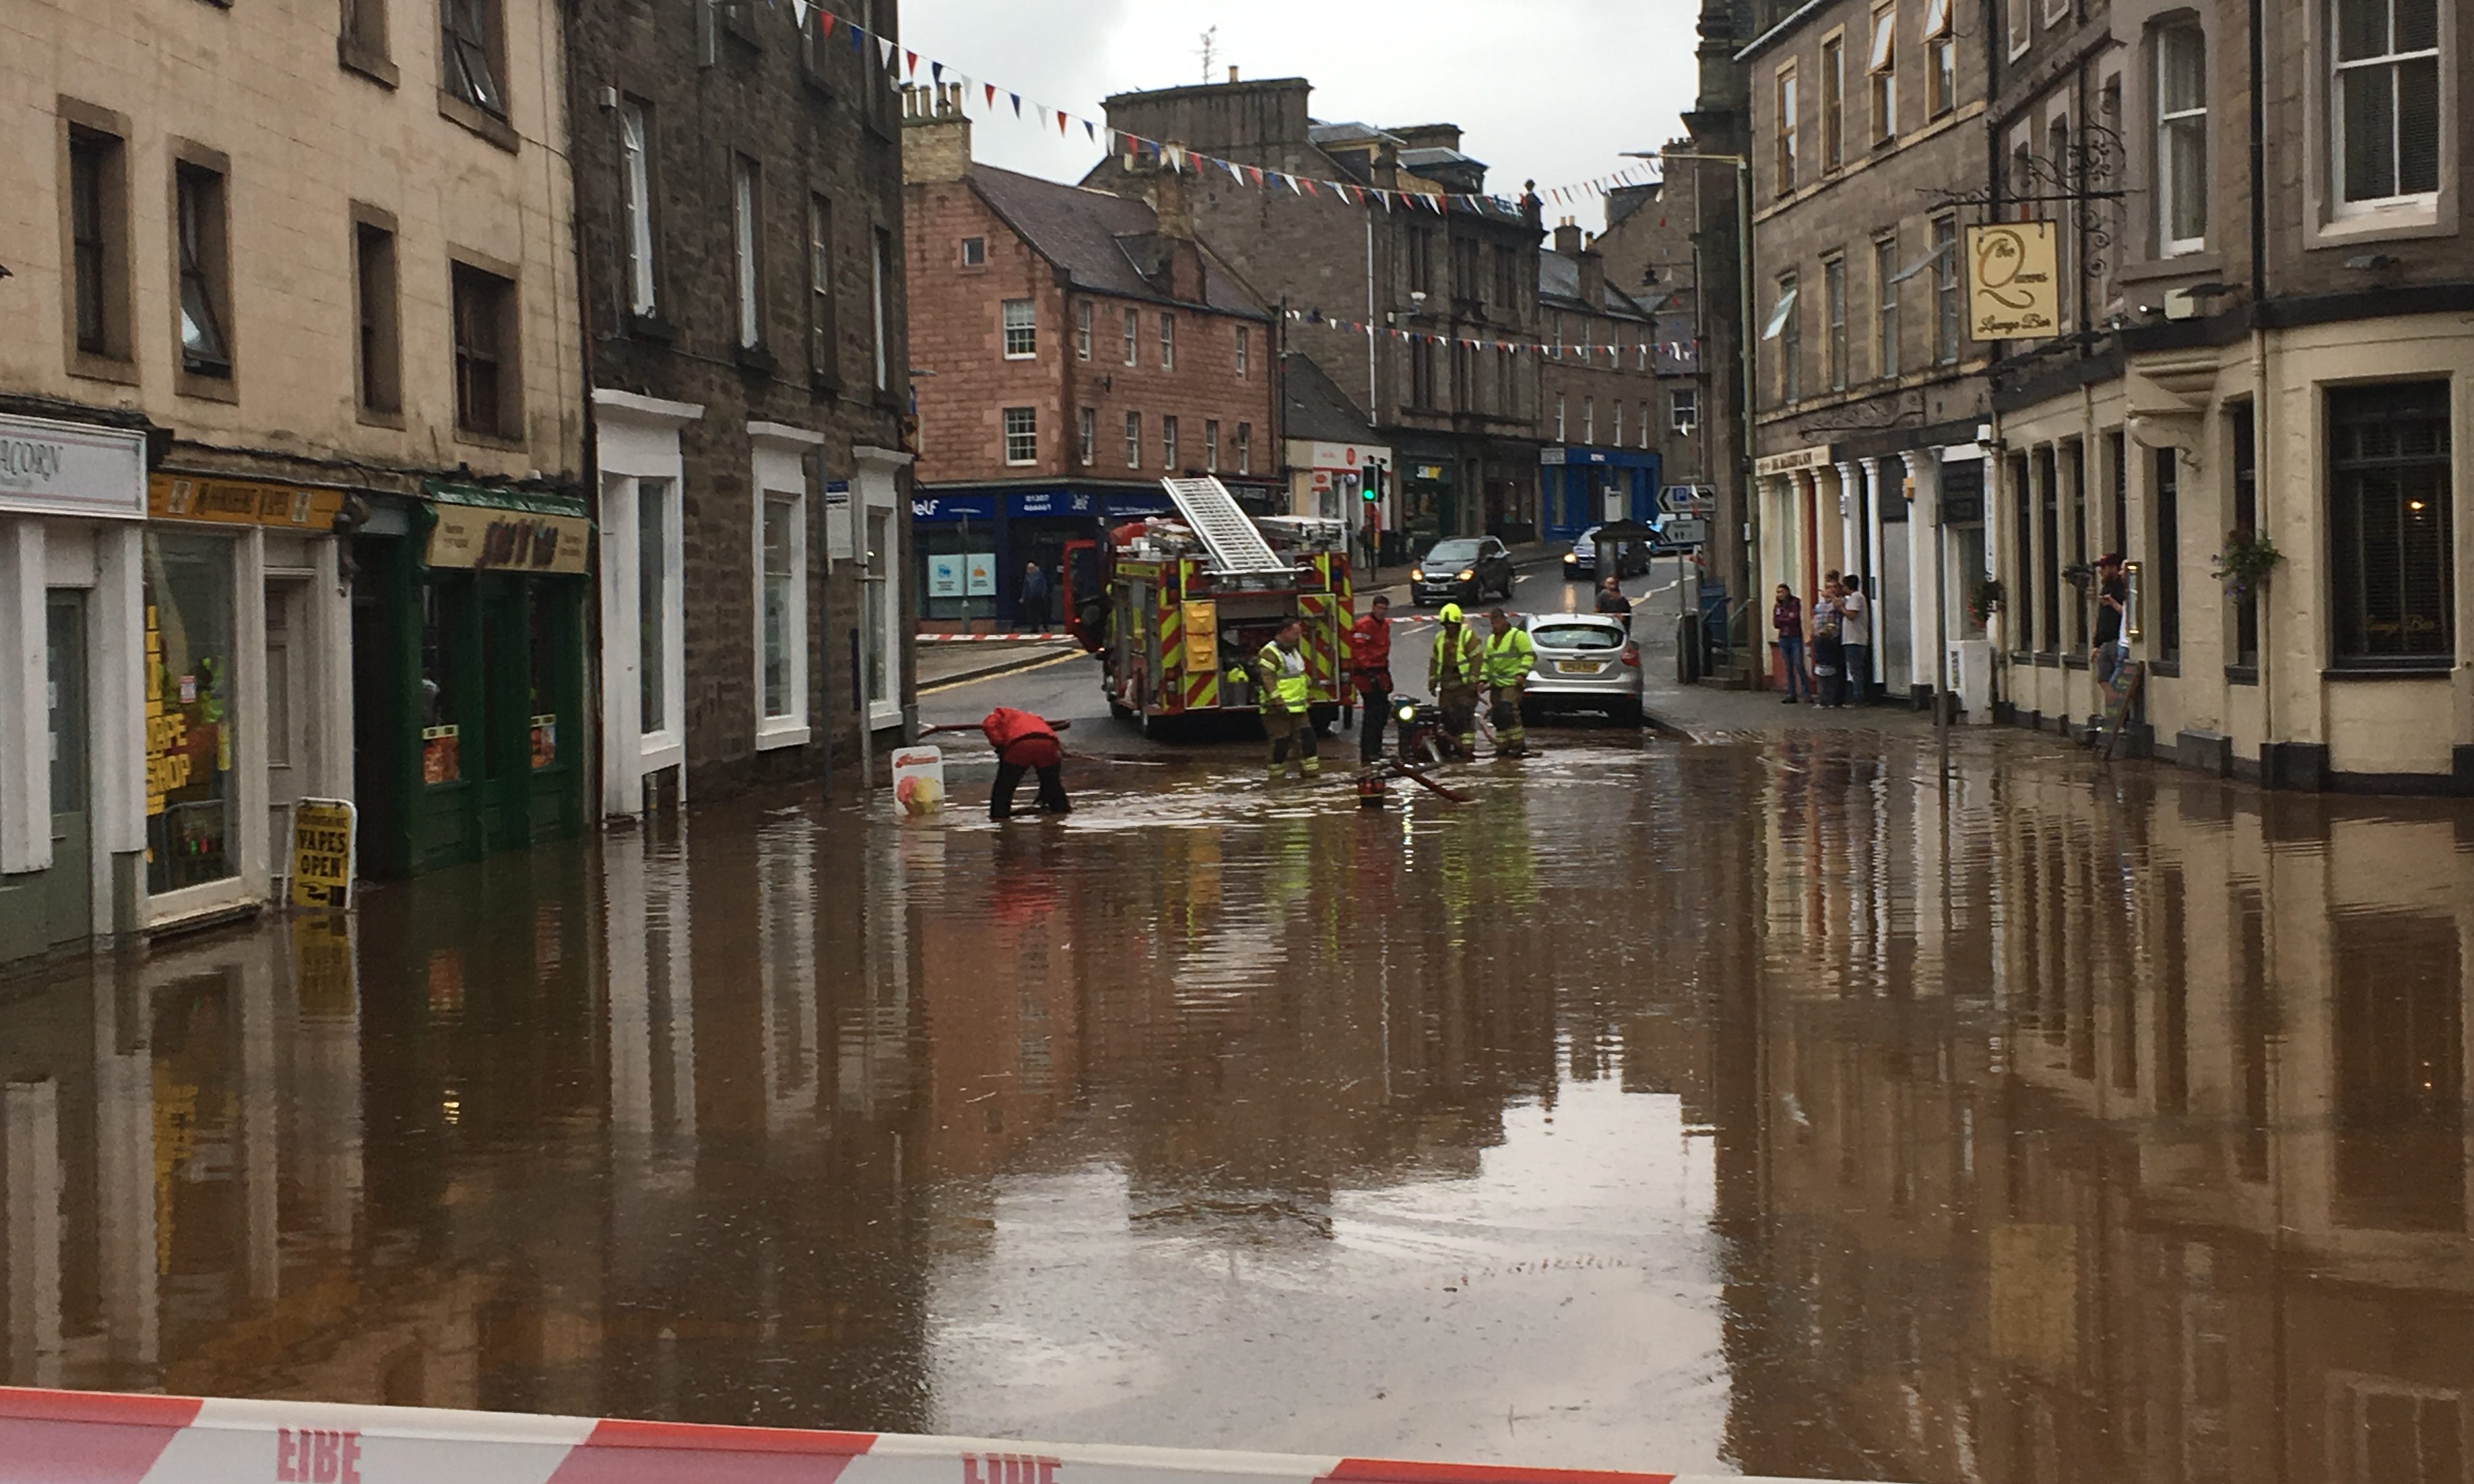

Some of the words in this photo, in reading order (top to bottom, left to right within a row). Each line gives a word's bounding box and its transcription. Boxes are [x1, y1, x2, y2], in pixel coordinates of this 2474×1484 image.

[1978, 314, 2019, 334] Lounge
[2021, 313, 2051, 329] Bar
[297, 829, 345, 853] VAPES
[301, 855, 341, 878] OPEN
